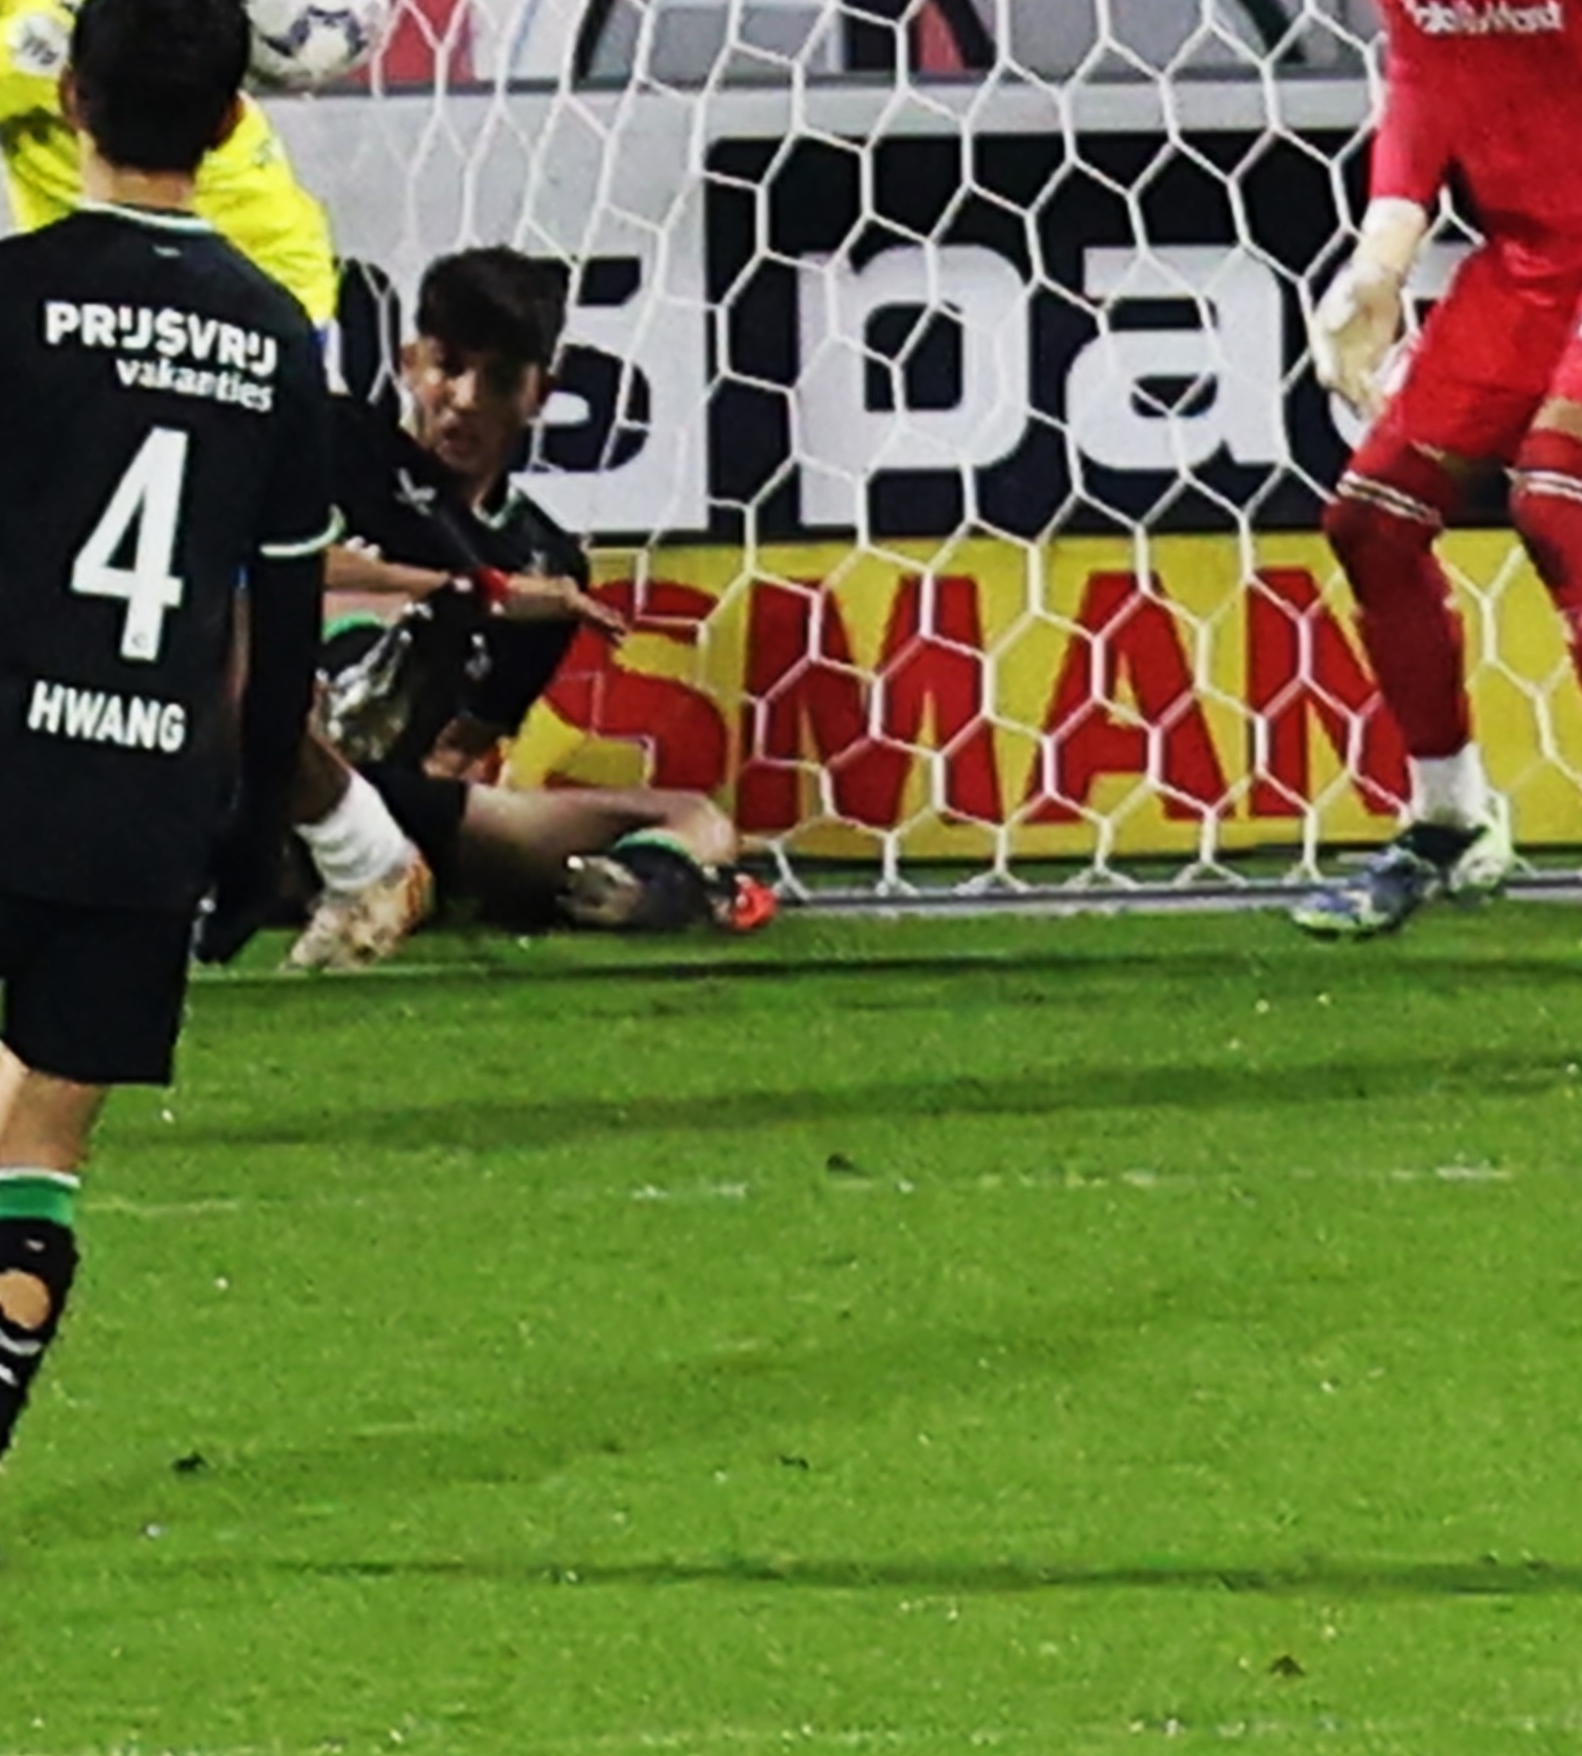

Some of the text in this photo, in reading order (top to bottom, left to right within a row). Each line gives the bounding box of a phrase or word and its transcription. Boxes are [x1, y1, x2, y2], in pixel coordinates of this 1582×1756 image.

[115, 357, 275, 413] vakanties
[71, 426, 188, 661] 4
[28, 681, 186, 753] HWANG
[542, 566, 1413, 830] SMAN
